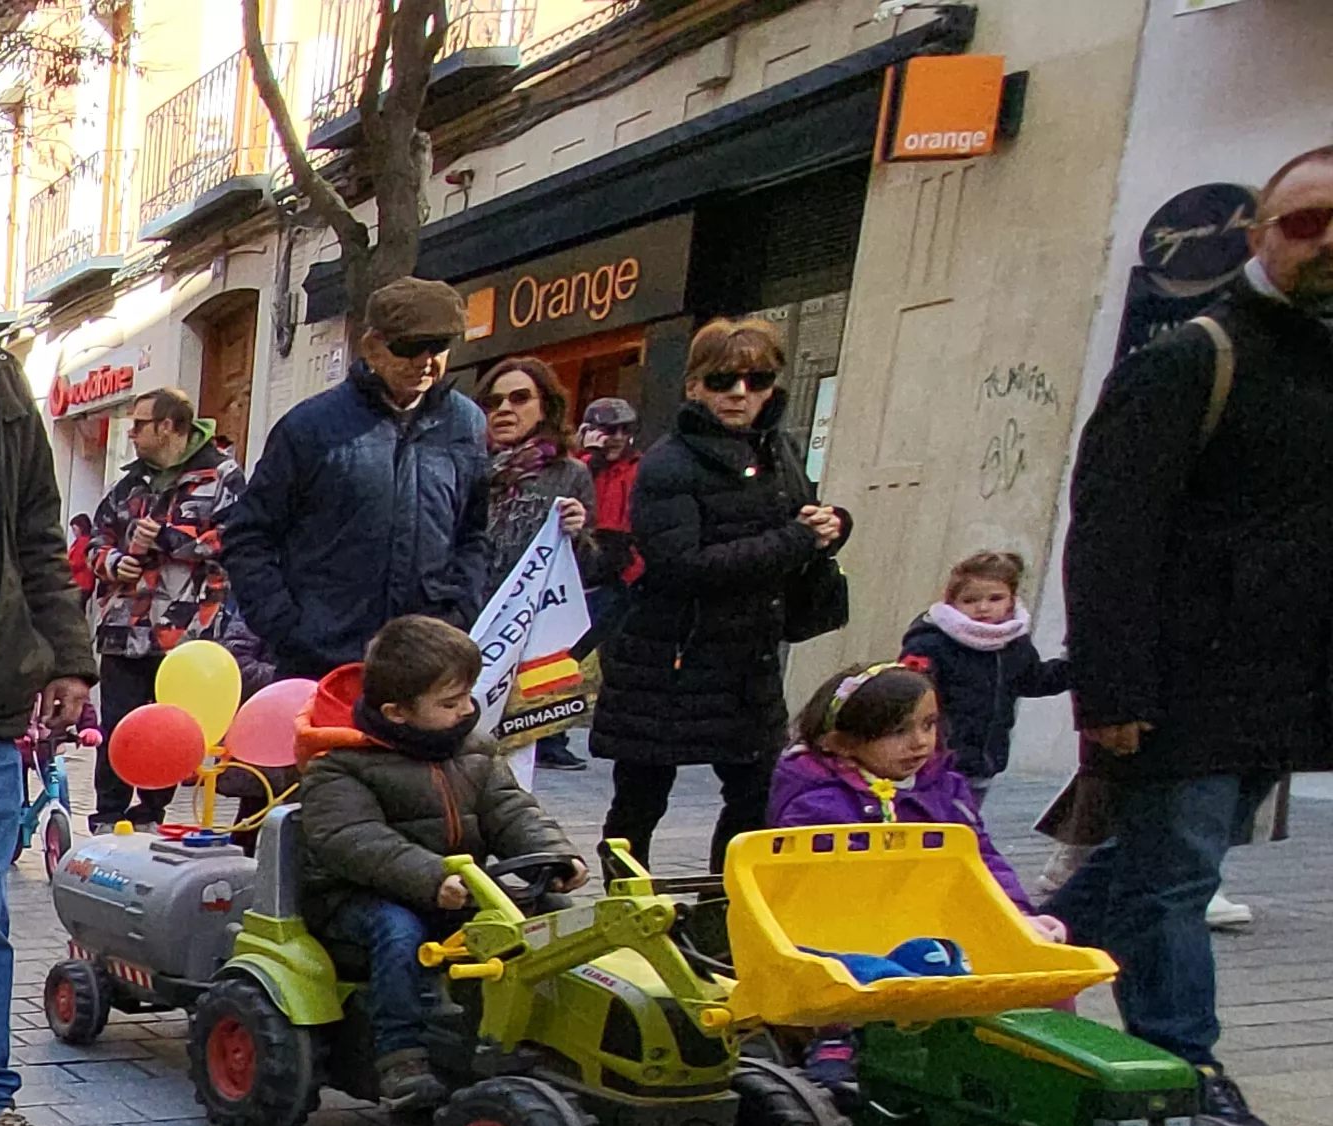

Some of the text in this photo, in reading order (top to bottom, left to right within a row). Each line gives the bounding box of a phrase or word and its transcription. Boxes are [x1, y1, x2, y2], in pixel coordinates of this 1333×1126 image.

[904, 130, 988, 154] orange
[509, 257, 640, 329] Orange
[502, 699, 585, 734] PRIMARIO
